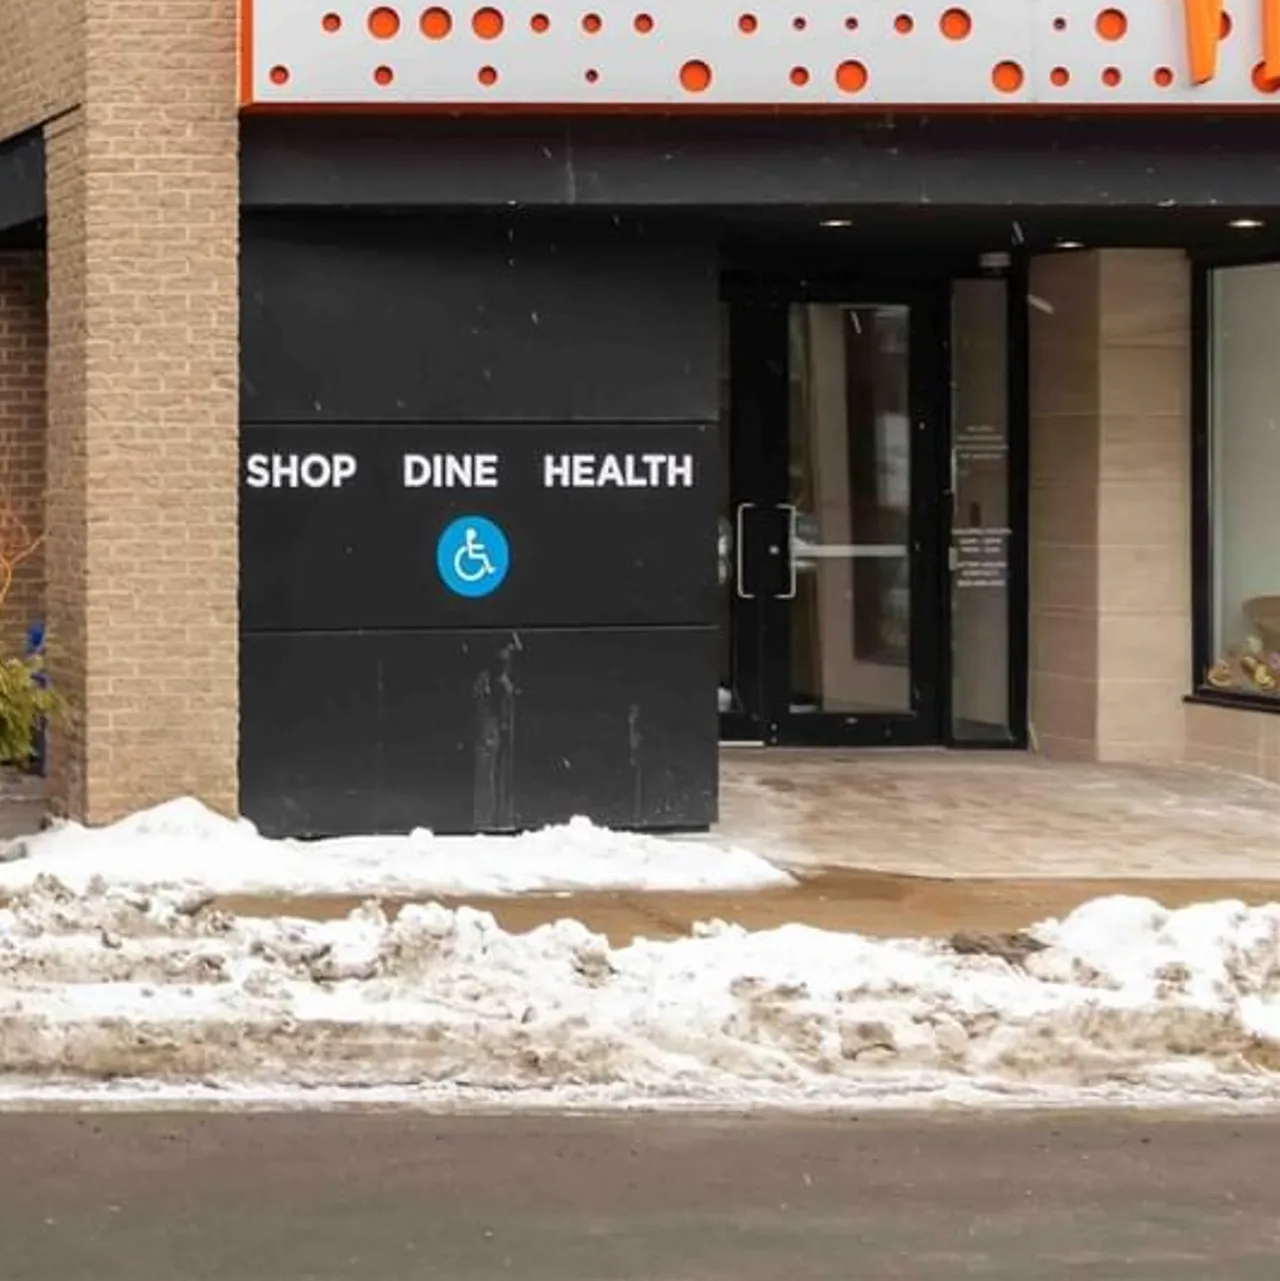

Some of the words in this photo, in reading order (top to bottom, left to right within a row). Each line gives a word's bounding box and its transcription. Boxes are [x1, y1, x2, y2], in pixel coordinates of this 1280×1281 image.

[246, 453, 357, 488] SHOP
[403, 453, 499, 488] DINE
[543, 453, 693, 488] HEALTH
